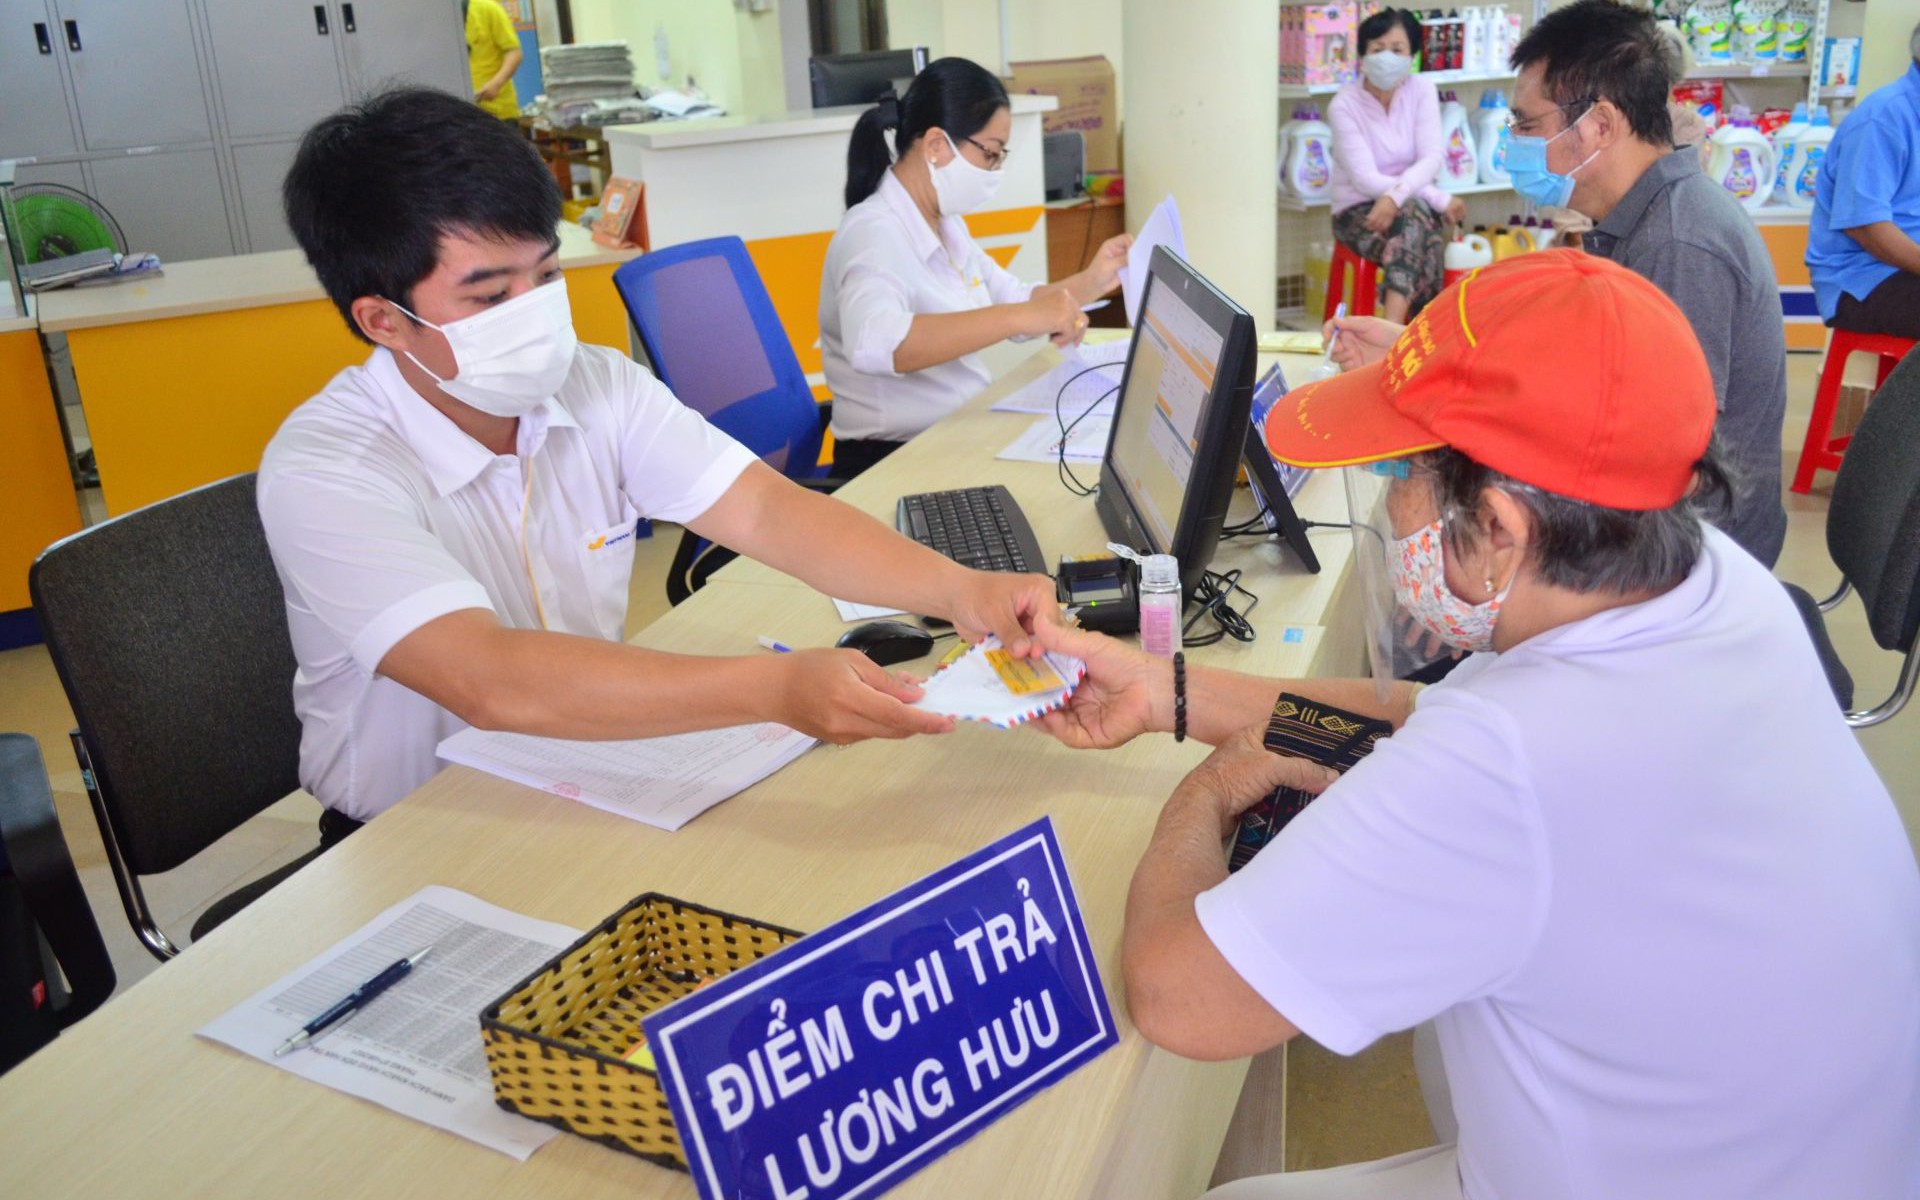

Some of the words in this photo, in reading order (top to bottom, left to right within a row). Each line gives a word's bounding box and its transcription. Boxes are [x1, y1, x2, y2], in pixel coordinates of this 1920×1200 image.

[706, 997, 855, 1132] ĐIỂM
[862, 950, 953, 1041] CHI
[954, 877, 1057, 985] TRẢ
[764, 1058, 955, 1200] LƯƠNG
[959, 988, 1060, 1092] HƯU
